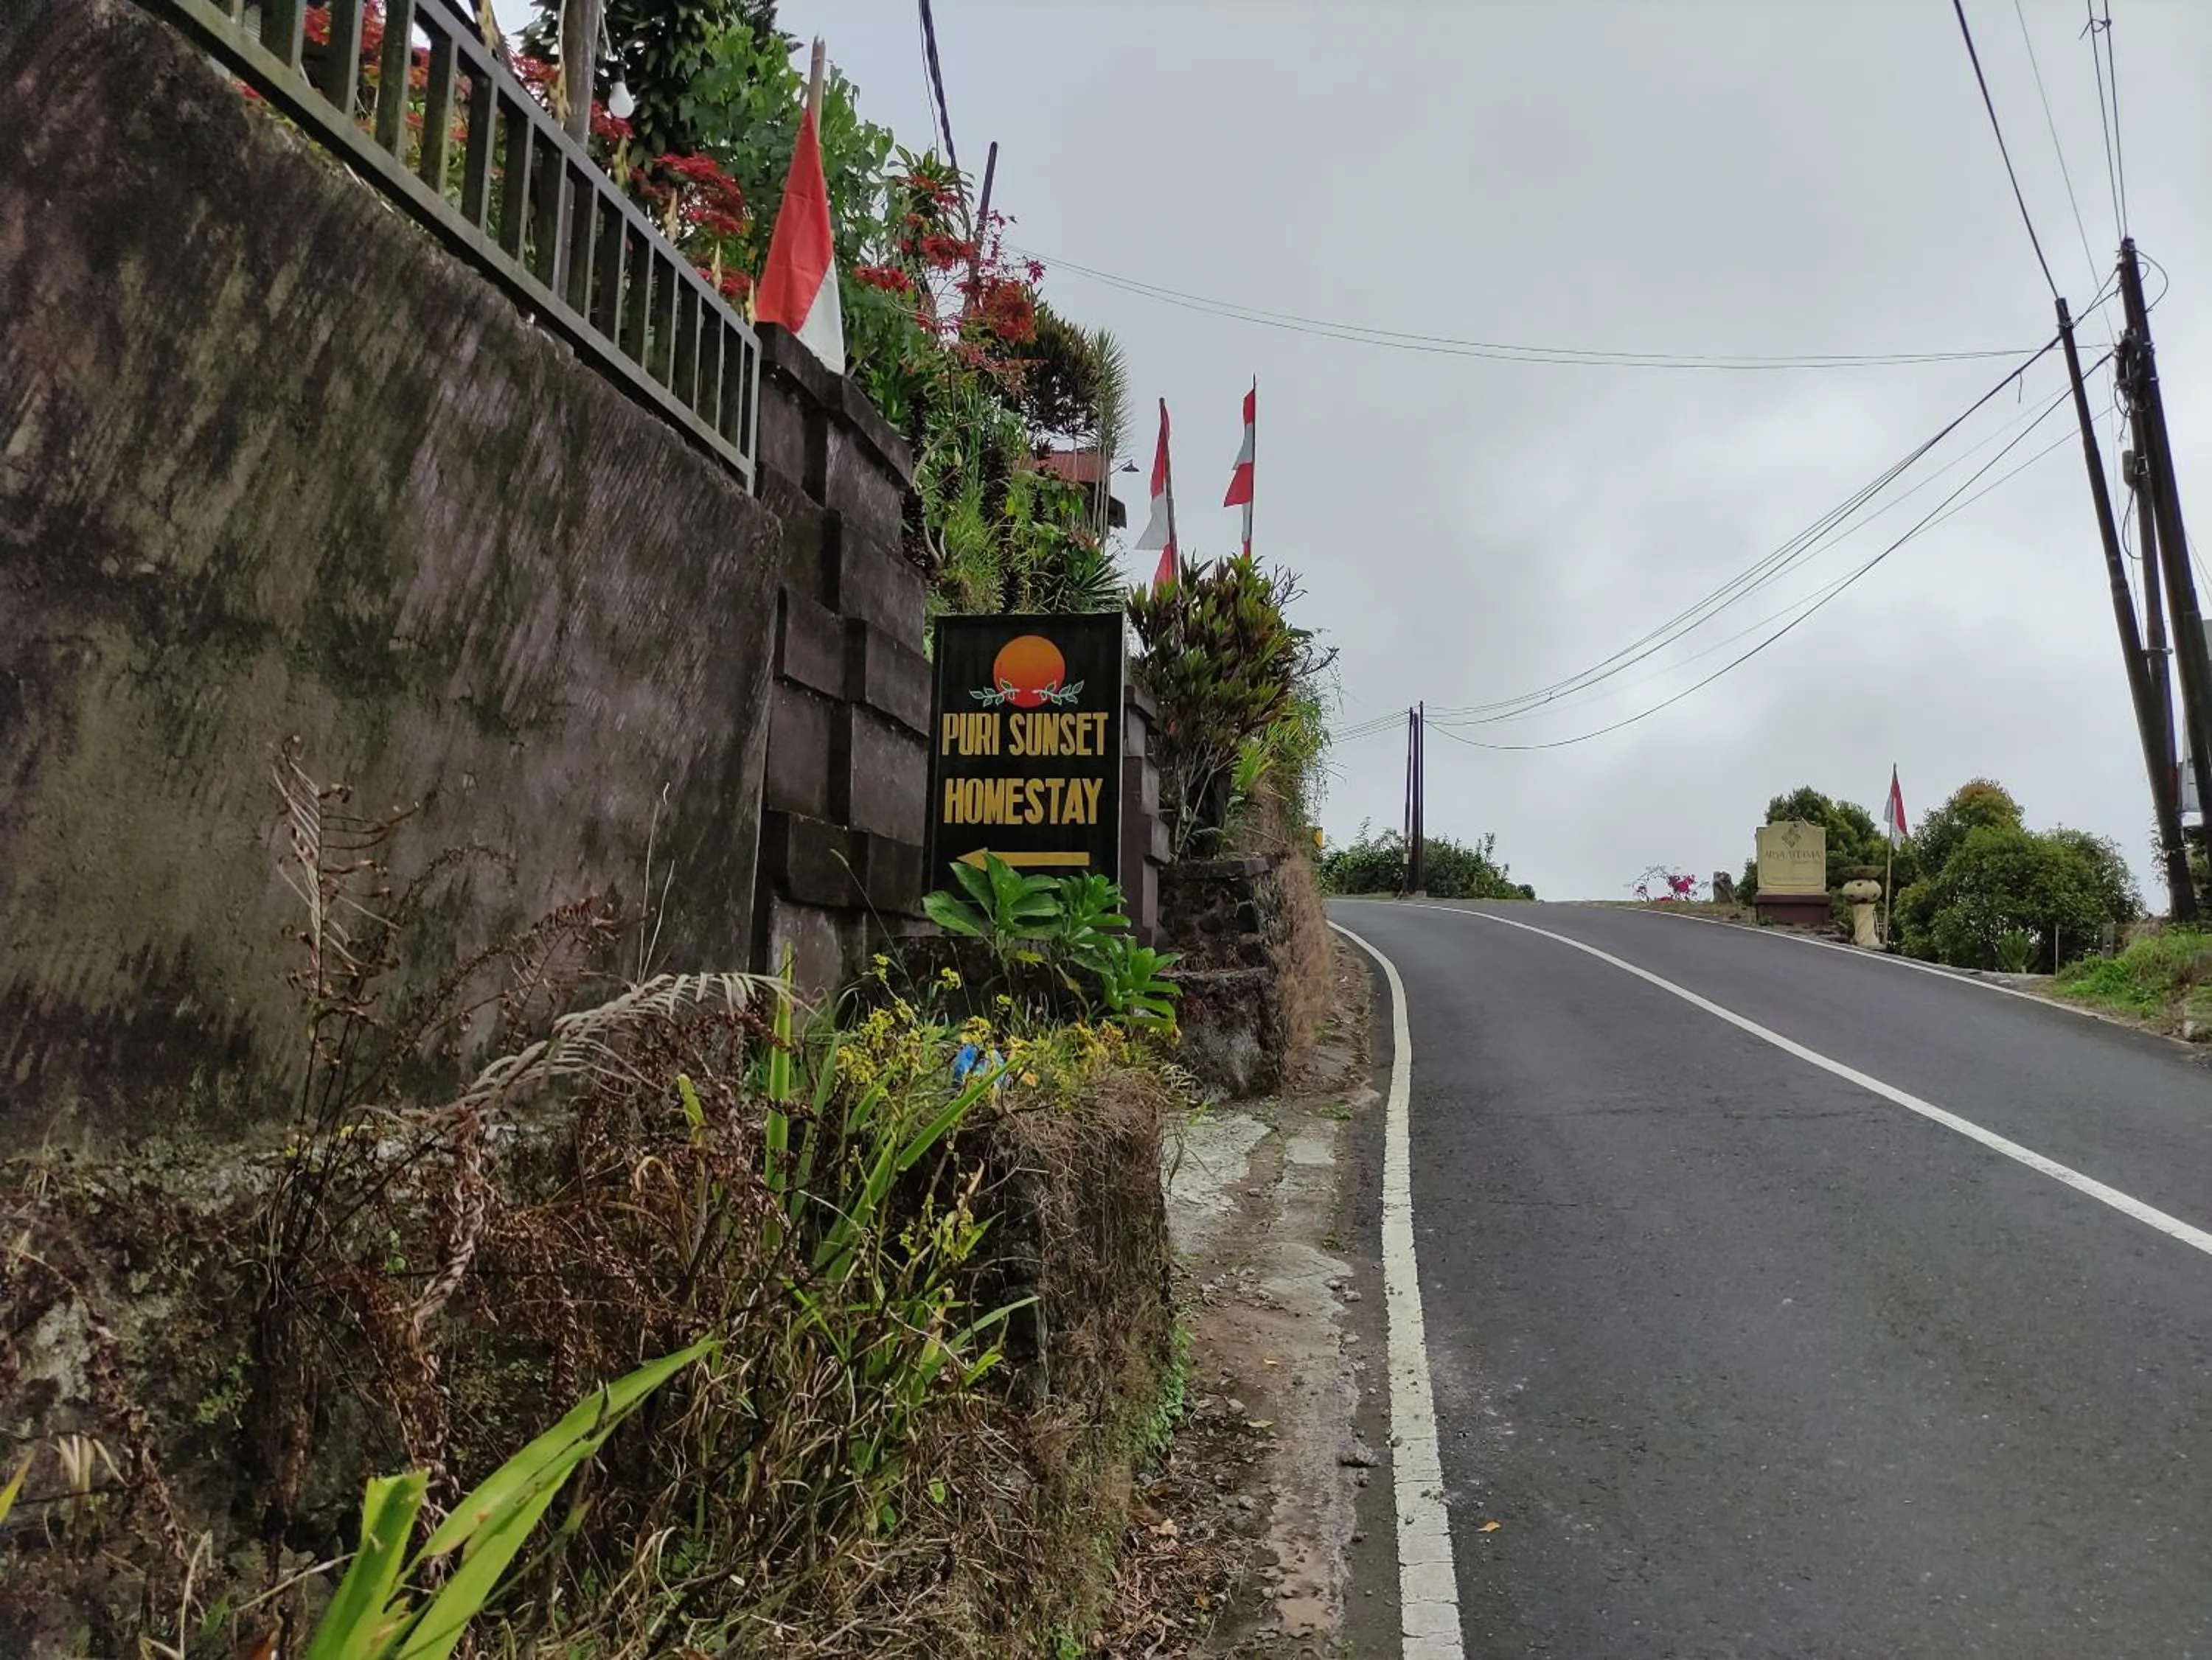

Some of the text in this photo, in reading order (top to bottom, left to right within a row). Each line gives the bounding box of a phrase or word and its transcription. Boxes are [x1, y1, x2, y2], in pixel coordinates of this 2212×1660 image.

[942, 712, 1109, 756] PURI SUNSET
[943, 778, 1104, 825] HOMESTAY
